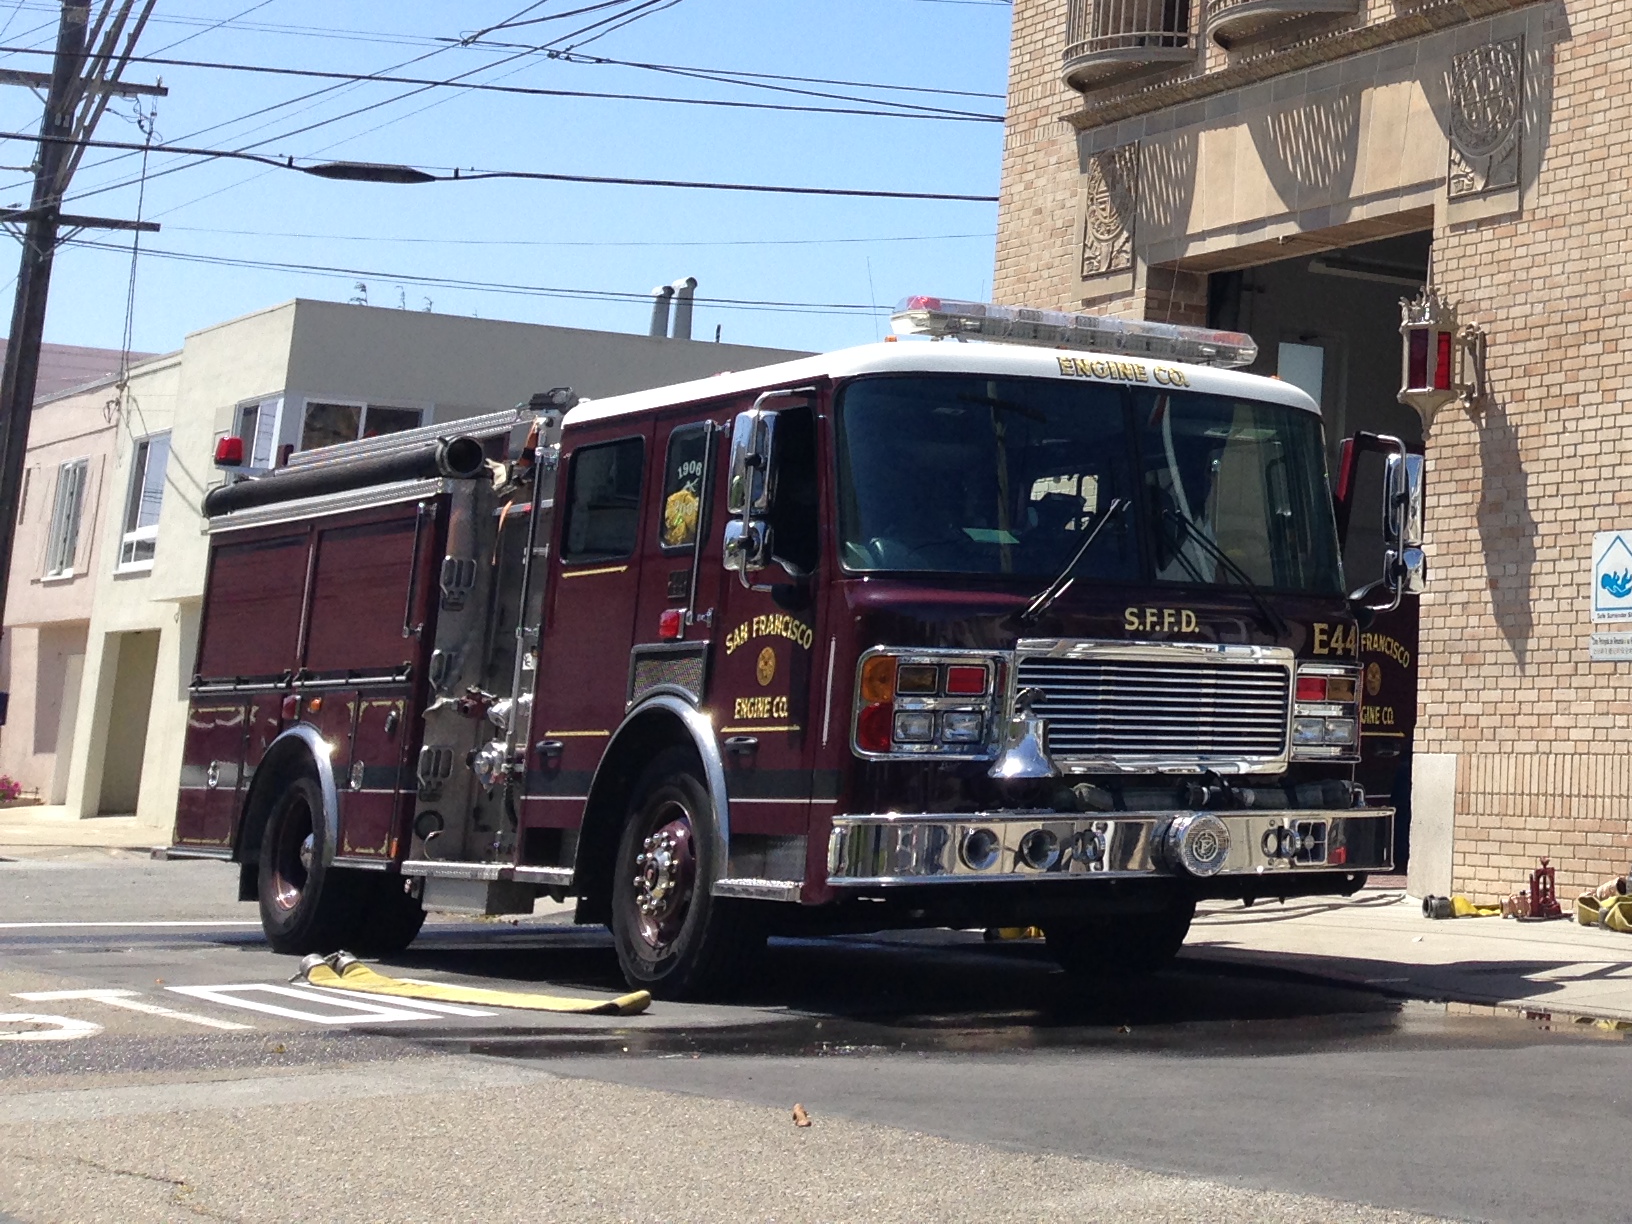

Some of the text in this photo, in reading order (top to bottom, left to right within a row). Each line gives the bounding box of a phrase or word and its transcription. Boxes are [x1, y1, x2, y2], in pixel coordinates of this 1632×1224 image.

[1056, 356, 1190, 387] ENGINE CO.
[677, 460, 702, 479] 1906
[1124, 607, 1200, 633] S.F.F.D.
[725, 614, 813, 655] SAN FRANCISCO
[1312, 622, 1357, 656] E44
[1361, 632, 1410, 668] FRANCISCO
[734, 696, 788, 719] ENGINE CO.
[1360, 705, 1395, 725] GINE CO.
